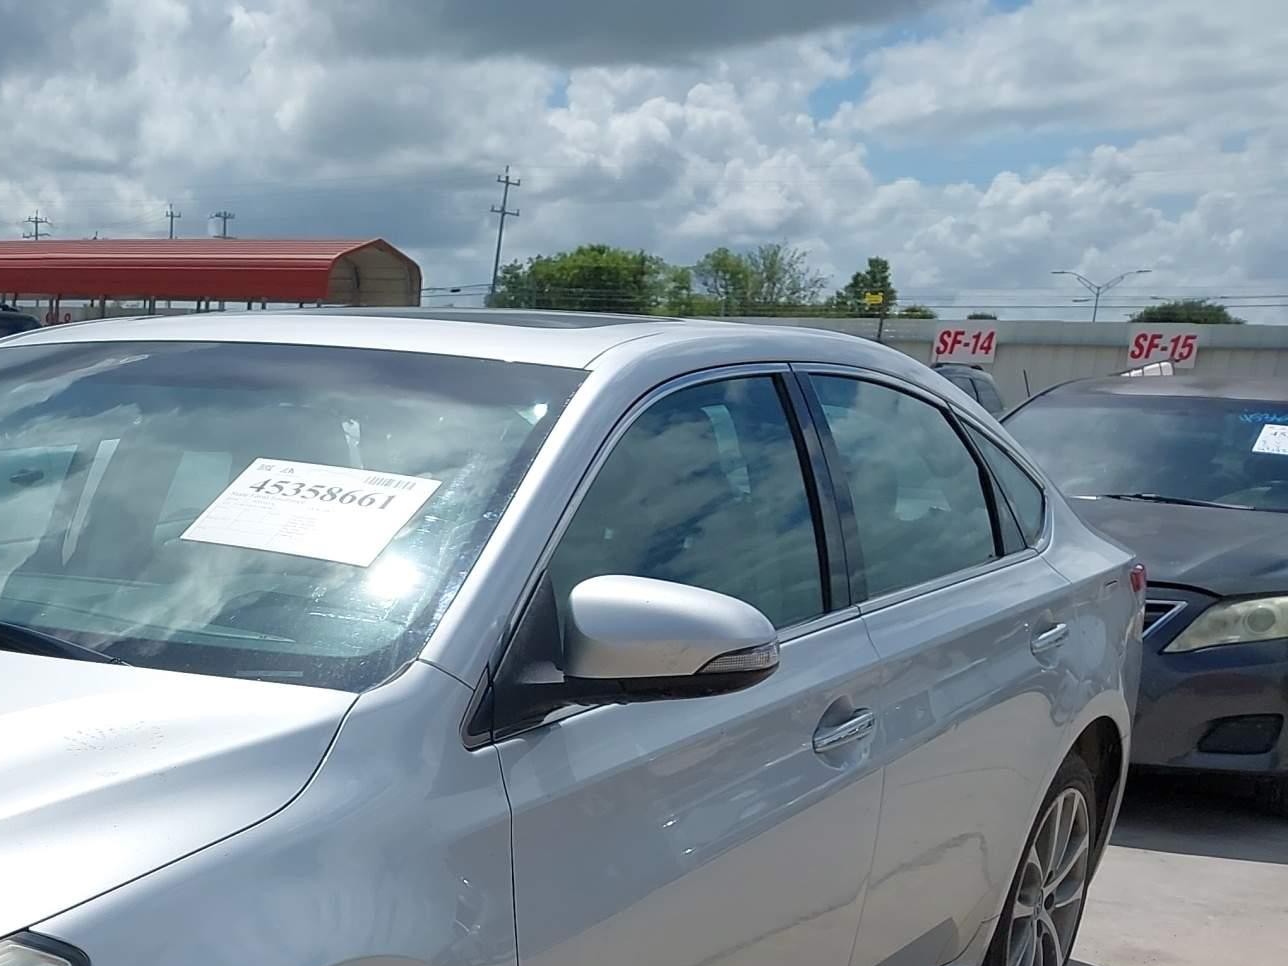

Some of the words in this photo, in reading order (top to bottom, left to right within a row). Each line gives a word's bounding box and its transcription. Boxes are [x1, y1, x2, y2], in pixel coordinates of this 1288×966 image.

[936, 330, 995, 355] SF-14
[1130, 333, 1197, 361] SF-15
[249, 479, 396, 509] 45358661
